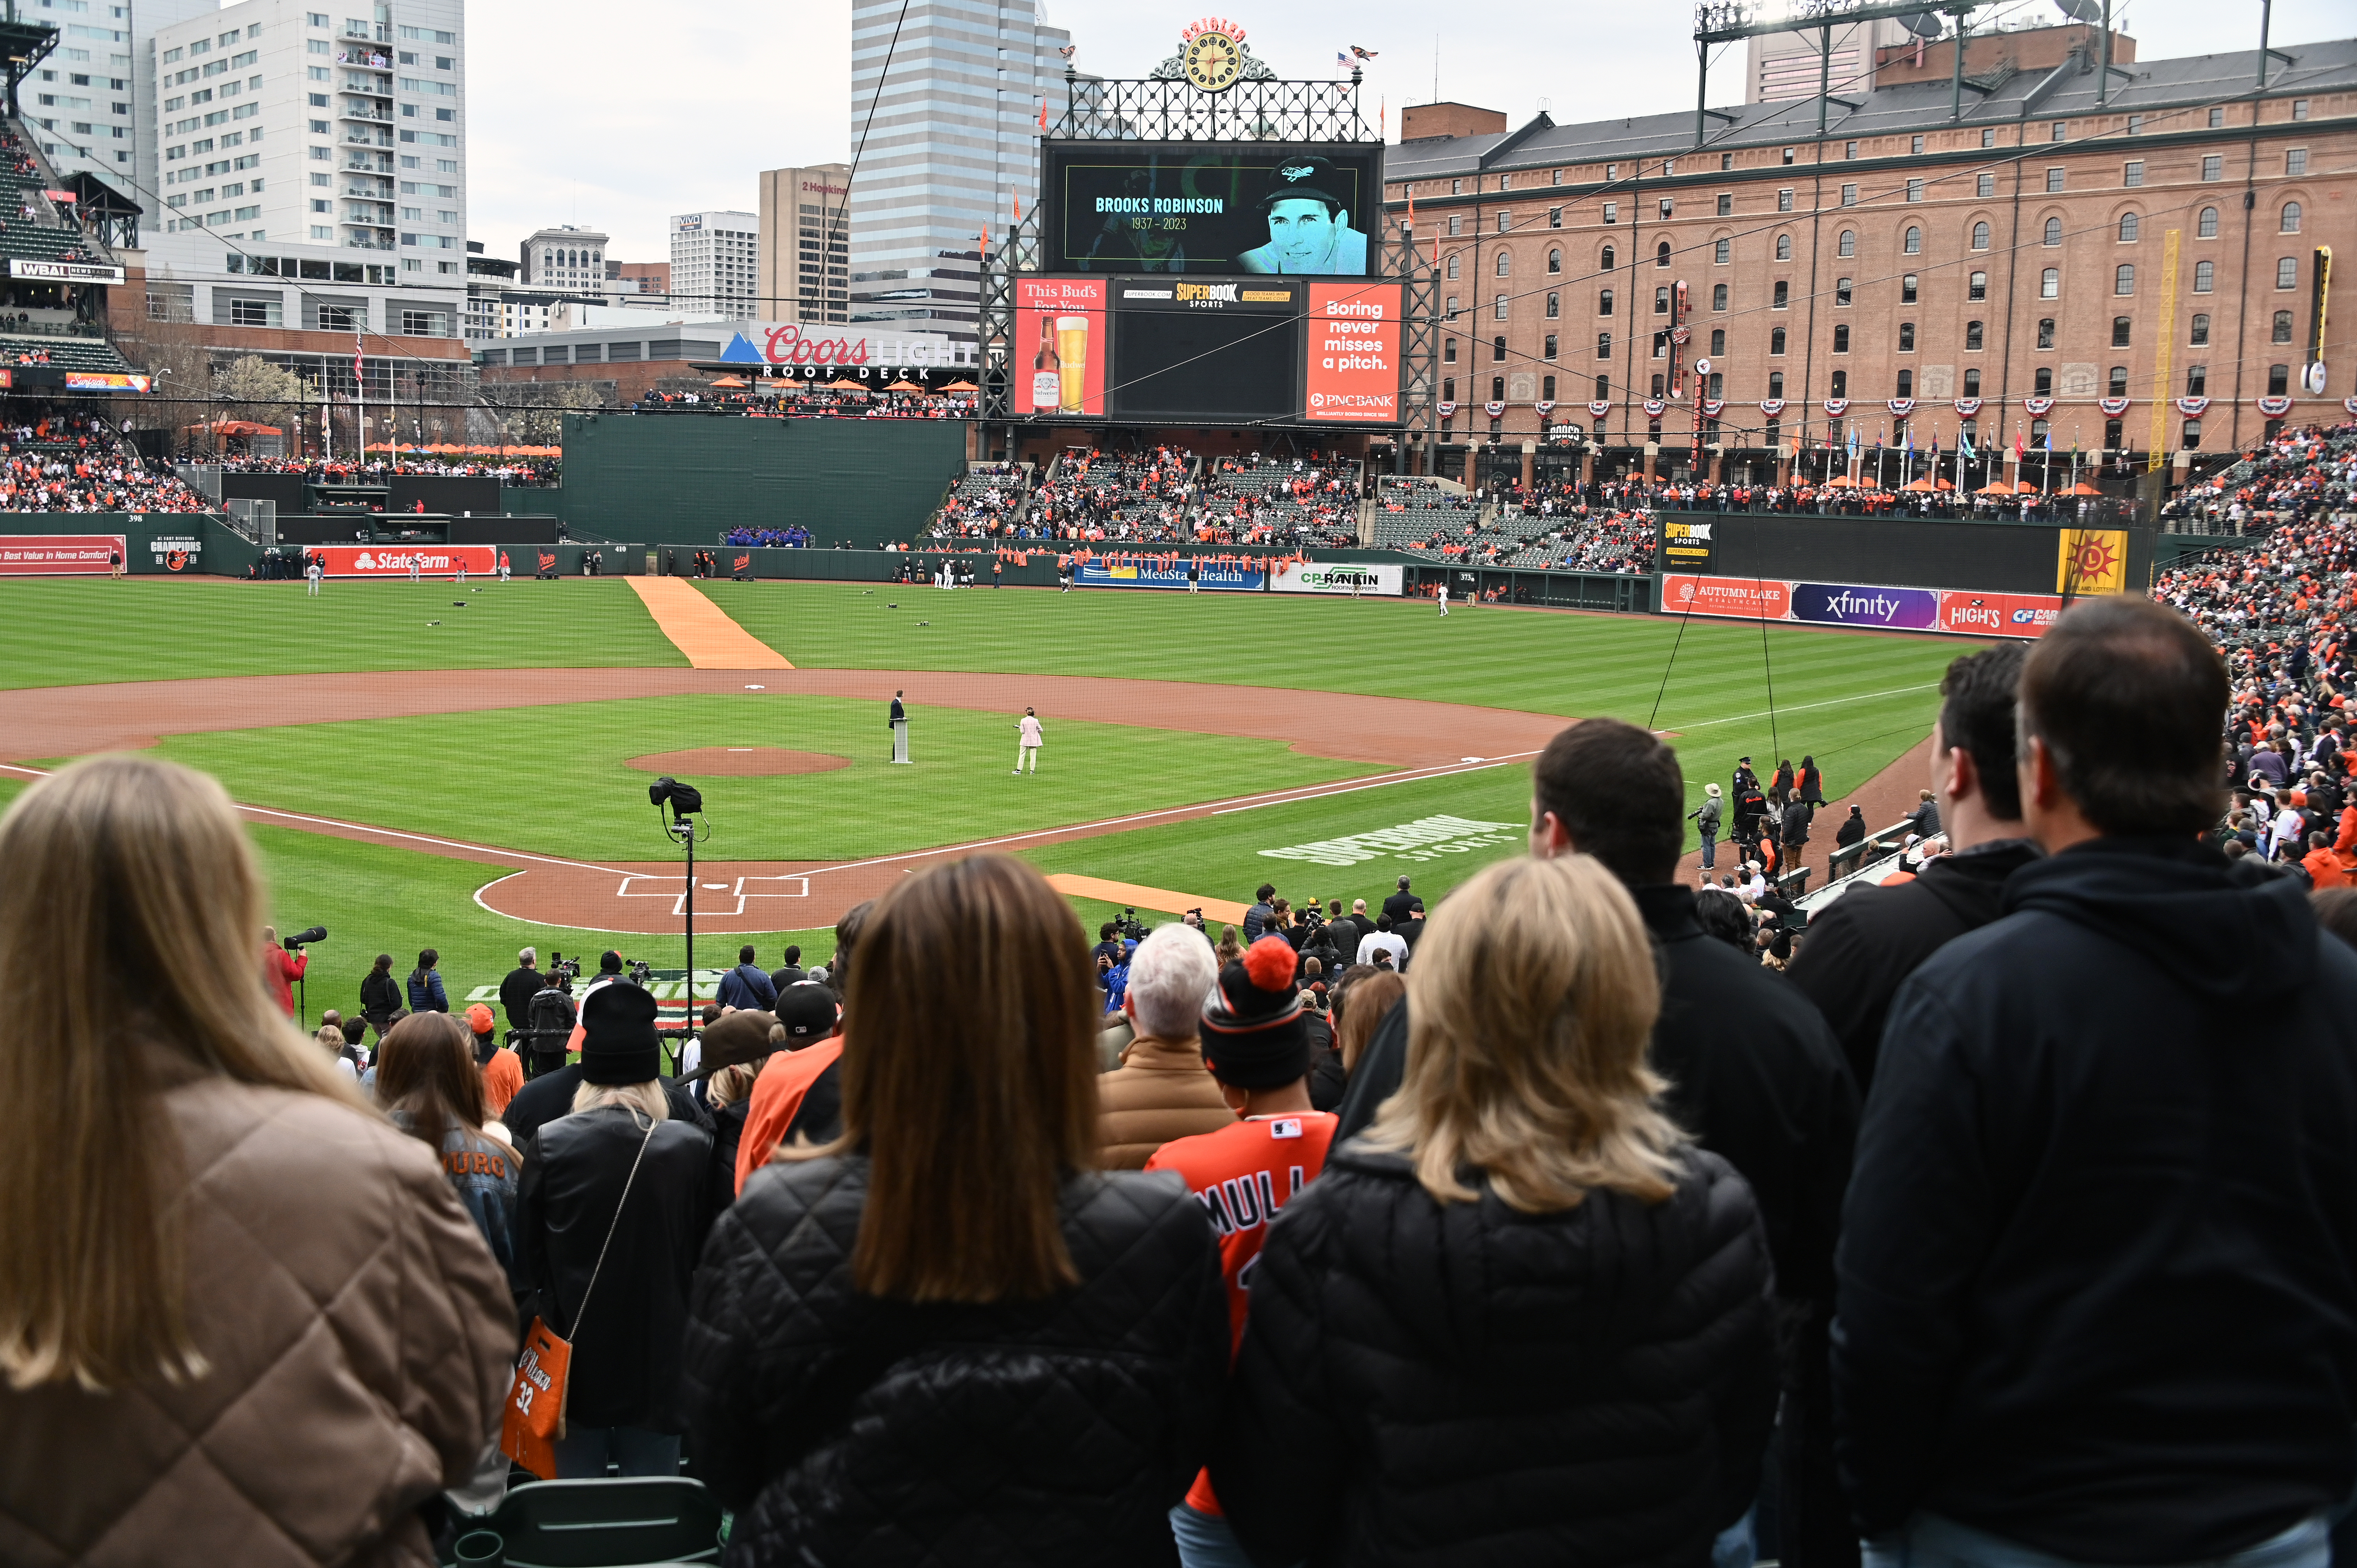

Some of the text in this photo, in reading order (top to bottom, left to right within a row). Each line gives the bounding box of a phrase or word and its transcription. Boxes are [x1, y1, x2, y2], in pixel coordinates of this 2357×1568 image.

[1182, 17, 1246, 42] ORIOLES
[802, 182, 847, 195] 2 Hopkins
[1095, 197, 1223, 214] BROOKS ROBINSON
[680, 215, 700, 225] VIVO
[1131, 217, 1152, 230] 1937
[1163, 217, 1186, 230] 2023
[22, 264, 69, 276] WBAL
[1025, 284, 1097, 297] This Bud's
[1176, 283, 1238, 302] SUPERBOOK
[1034, 300, 1088, 313] For You.
[1327, 300, 1383, 320] Boring
[1330, 322, 1380, 334] never
[764, 325, 977, 366] Coors LIGHT
[1324, 335, 1383, 352] misses
[1322, 354, 1387, 373] a pitch.
[763, 366, 929, 380] ROOF DECK
[70, 373, 107, 388] Surfside
[1665, 522, 1712, 540] SUPERBOOK
[151, 541, 201, 552] CHAMPIONS
[4, 551, 22, 560] Best
[79, 551, 108, 559] Comfort
[2088, 553, 2097, 565] L
[1140, 569, 1189, 581] MedSta
[1324, 573, 1378, 585] RANIN
[1699, 586, 1780, 600] AUTUMN LAKE
[1709, 597, 1769, 606] HEALTHCARE
[1826, 590, 1900, 622] xfinity
[1951, 607, 2000, 628] HIGH'S
[1256, 814, 1528, 866] SUPERBOOK
[1394, 833, 1519, 861] SPORTS
[442, 1151, 505, 1179] URG
[516, 1380, 534, 1416] 32
